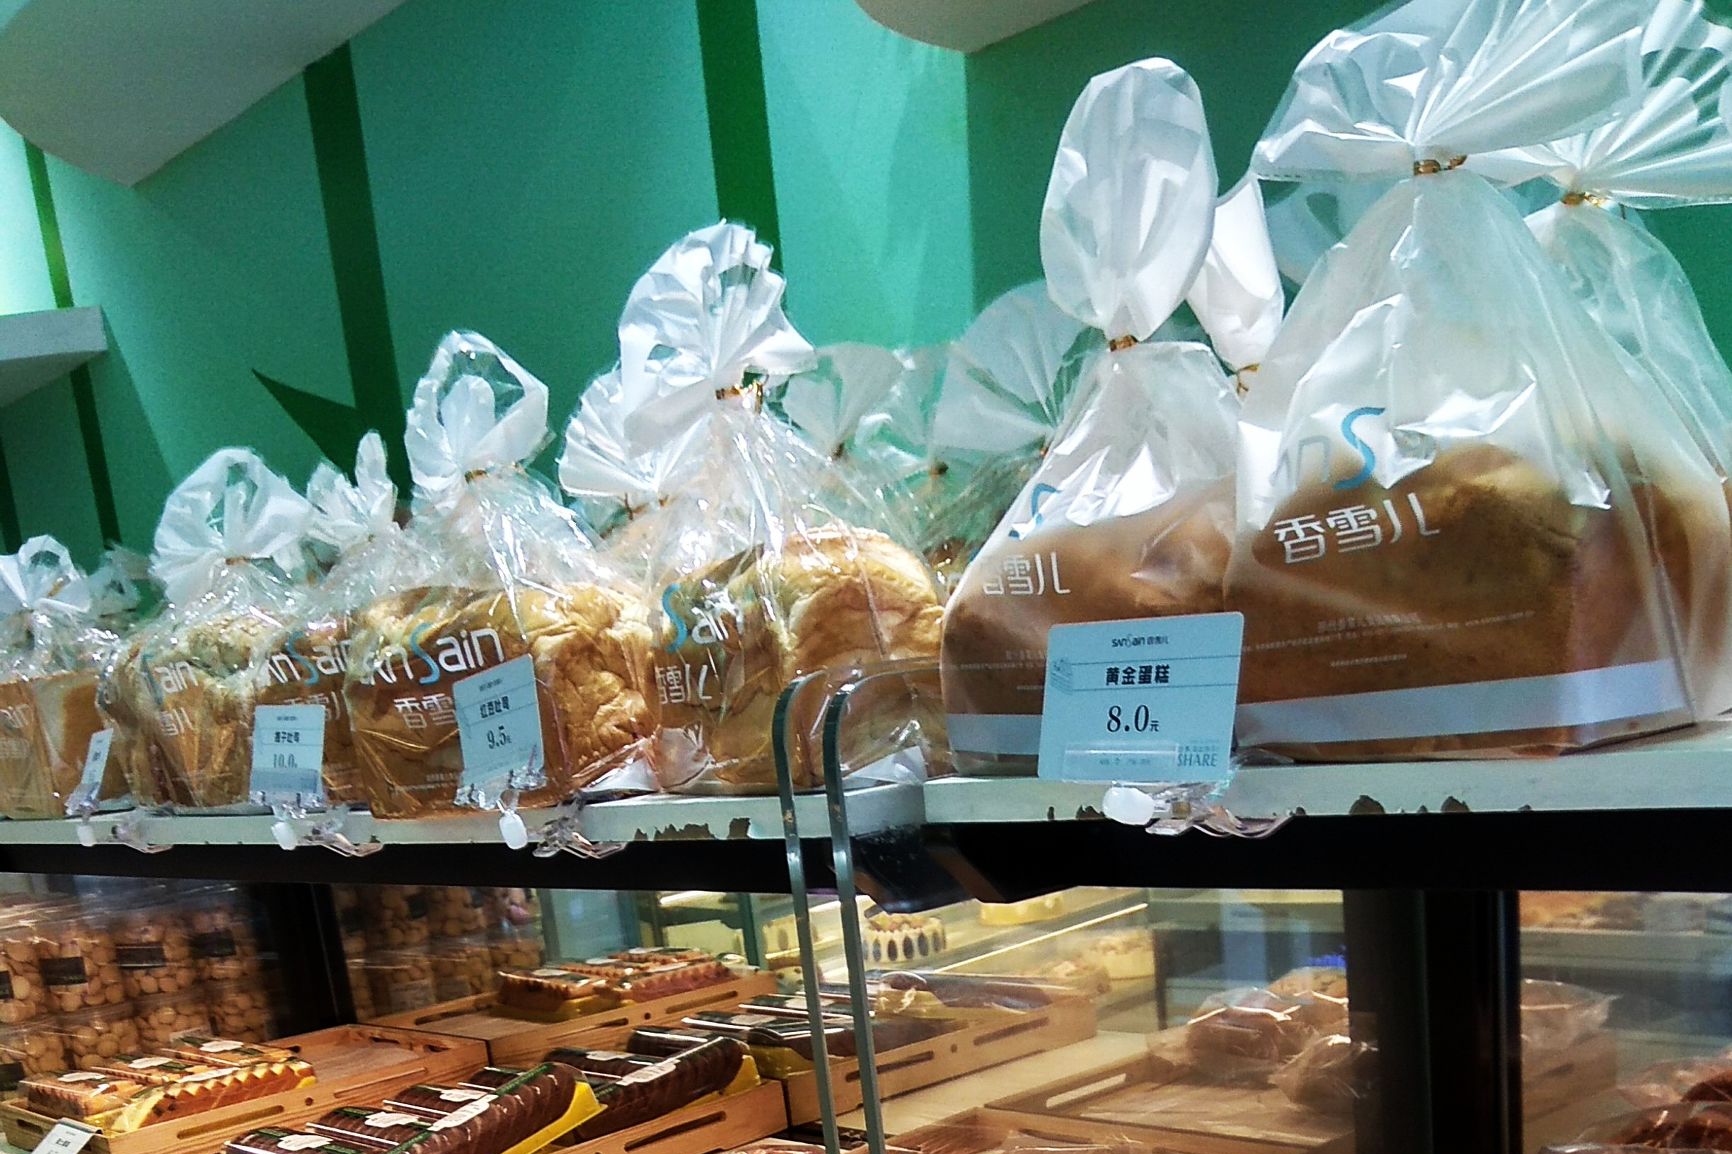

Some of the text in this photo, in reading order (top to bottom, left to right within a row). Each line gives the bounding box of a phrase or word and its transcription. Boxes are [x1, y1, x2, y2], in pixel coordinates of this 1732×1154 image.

[1274, 492, 1441, 565] 香雪儿
[1106, 664, 1170, 686] 黄金蛋糕
[394, 692, 456, 729] 香雪
